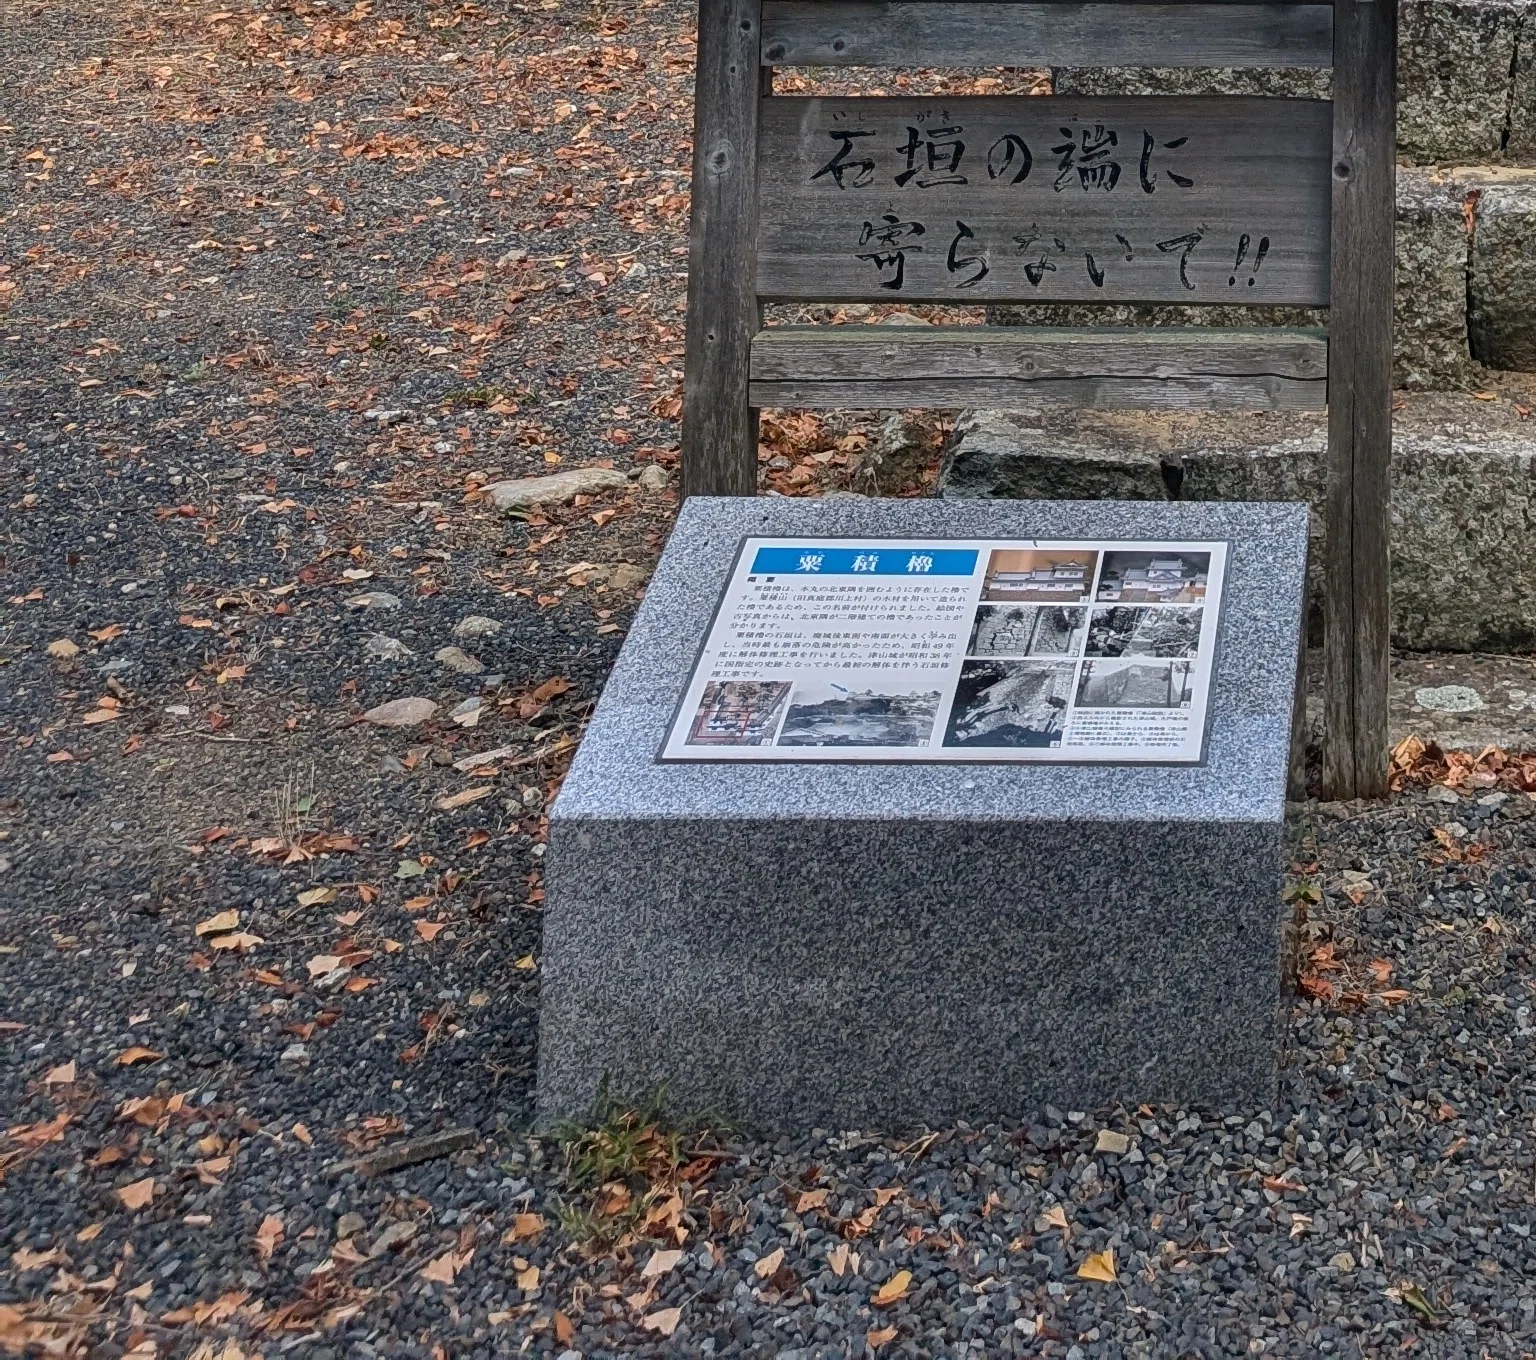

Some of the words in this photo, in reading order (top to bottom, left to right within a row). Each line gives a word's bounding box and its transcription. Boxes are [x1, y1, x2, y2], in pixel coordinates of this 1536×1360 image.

[810, 125, 1194, 194] 石垣の端に
[710, 670, 764, 678] 理工事です。
